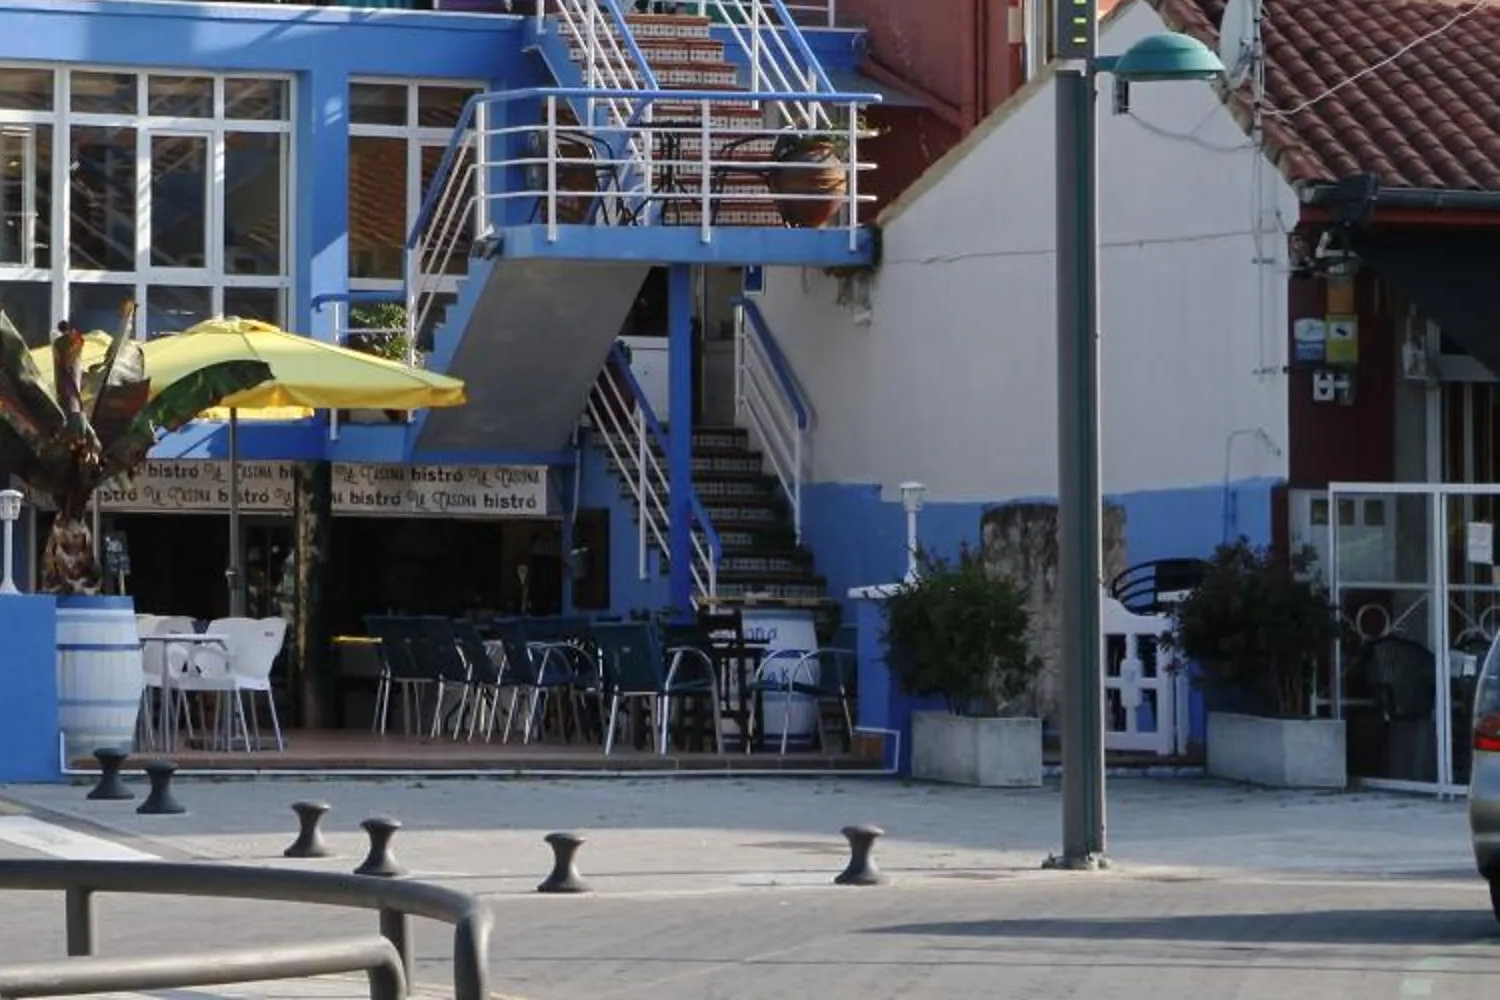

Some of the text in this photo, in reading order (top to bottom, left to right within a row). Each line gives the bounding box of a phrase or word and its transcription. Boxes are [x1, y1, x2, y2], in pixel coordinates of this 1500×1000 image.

[148, 462, 199, 479] bistró
[411, 465, 463, 483] bistró
[483, 492, 537, 509] bistró
